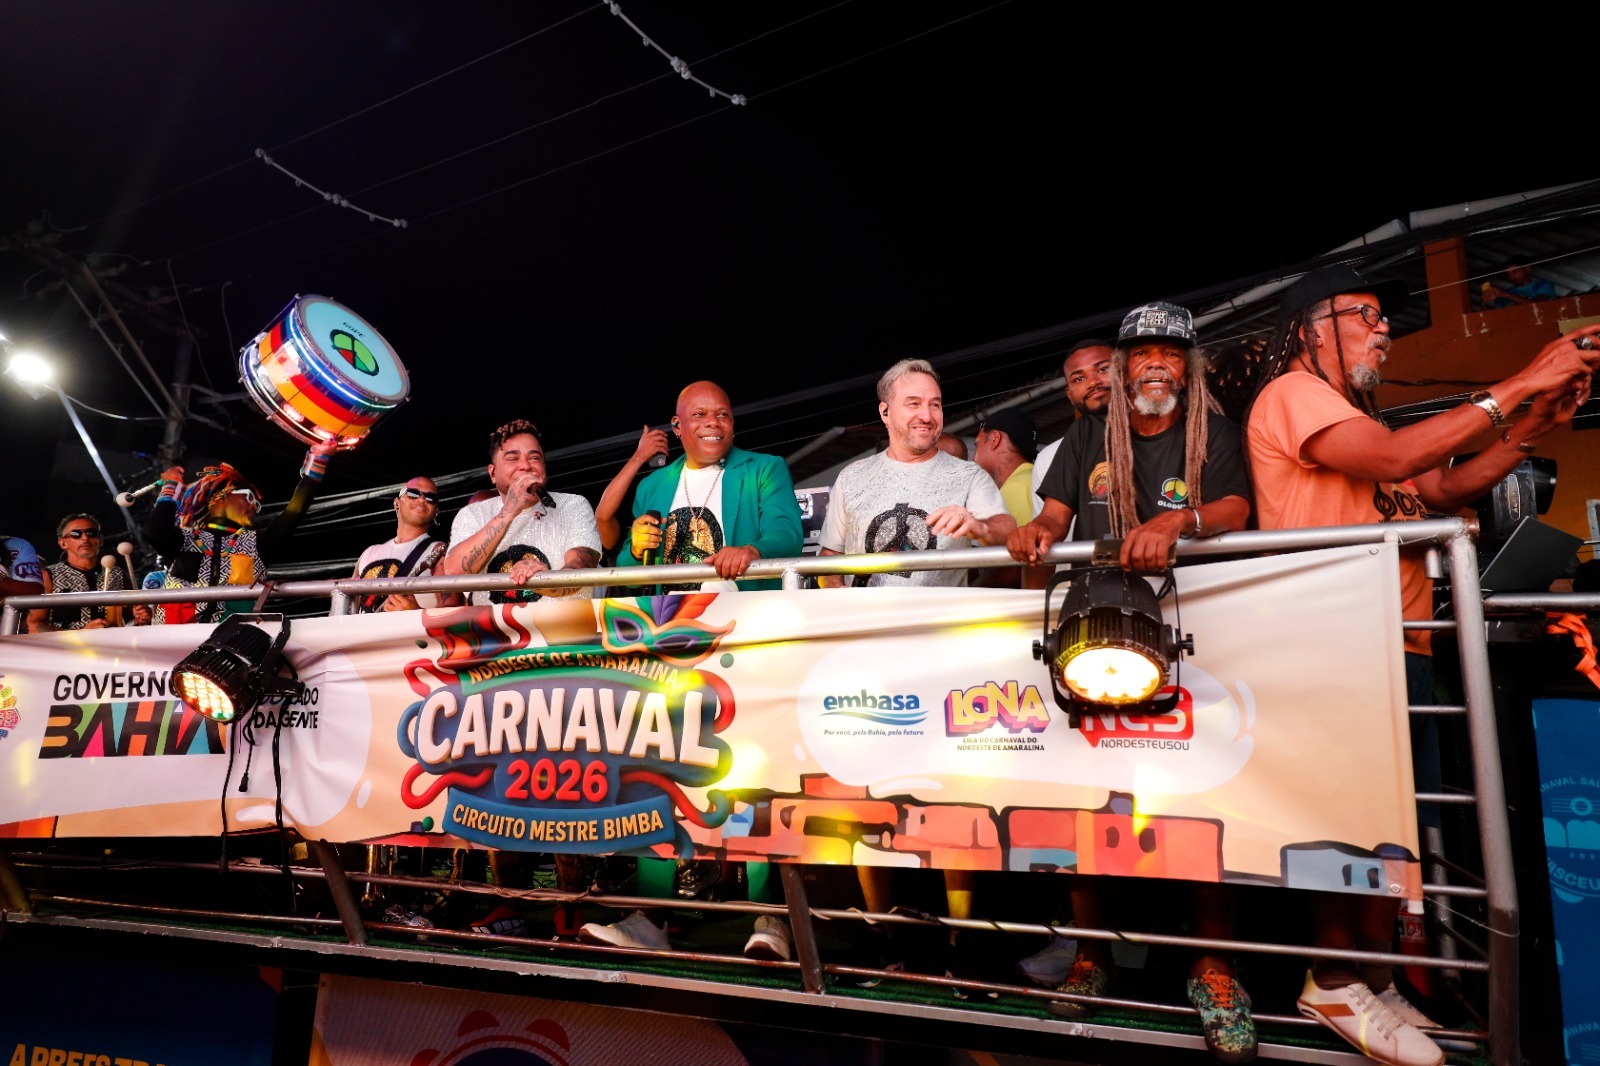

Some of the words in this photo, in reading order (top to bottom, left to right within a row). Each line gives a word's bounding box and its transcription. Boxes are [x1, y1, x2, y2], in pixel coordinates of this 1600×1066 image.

[1157, 500, 1189, 509] OLODU
[467, 652, 547, 685] NORDESTE
[550, 652, 575, 666] DE
[578, 653, 680, 690] AMARALINA
[823, 689, 920, 710] embasa
[945, 680, 1051, 734] LONA
[38, 700, 225, 759] BAHIA
[254, 711, 277, 728] DA
[280, 711, 319, 729] GENTE
[417, 687, 720, 768] CARNAVAL
[853, 729, 867, 737] pela
[867, 729, 886, 737] Bahia,
[887, 729, 902, 737] pelo
[1101, 739, 1190, 750] NORDESTEUSOU
[504, 758, 609, 802] 2026
[1540, 777, 1576, 793] NAVAL
[452, 804, 526, 839] CIRCUITO
[529, 819, 598, 842] MESTRE
[603, 809, 664, 840] BIMBA
